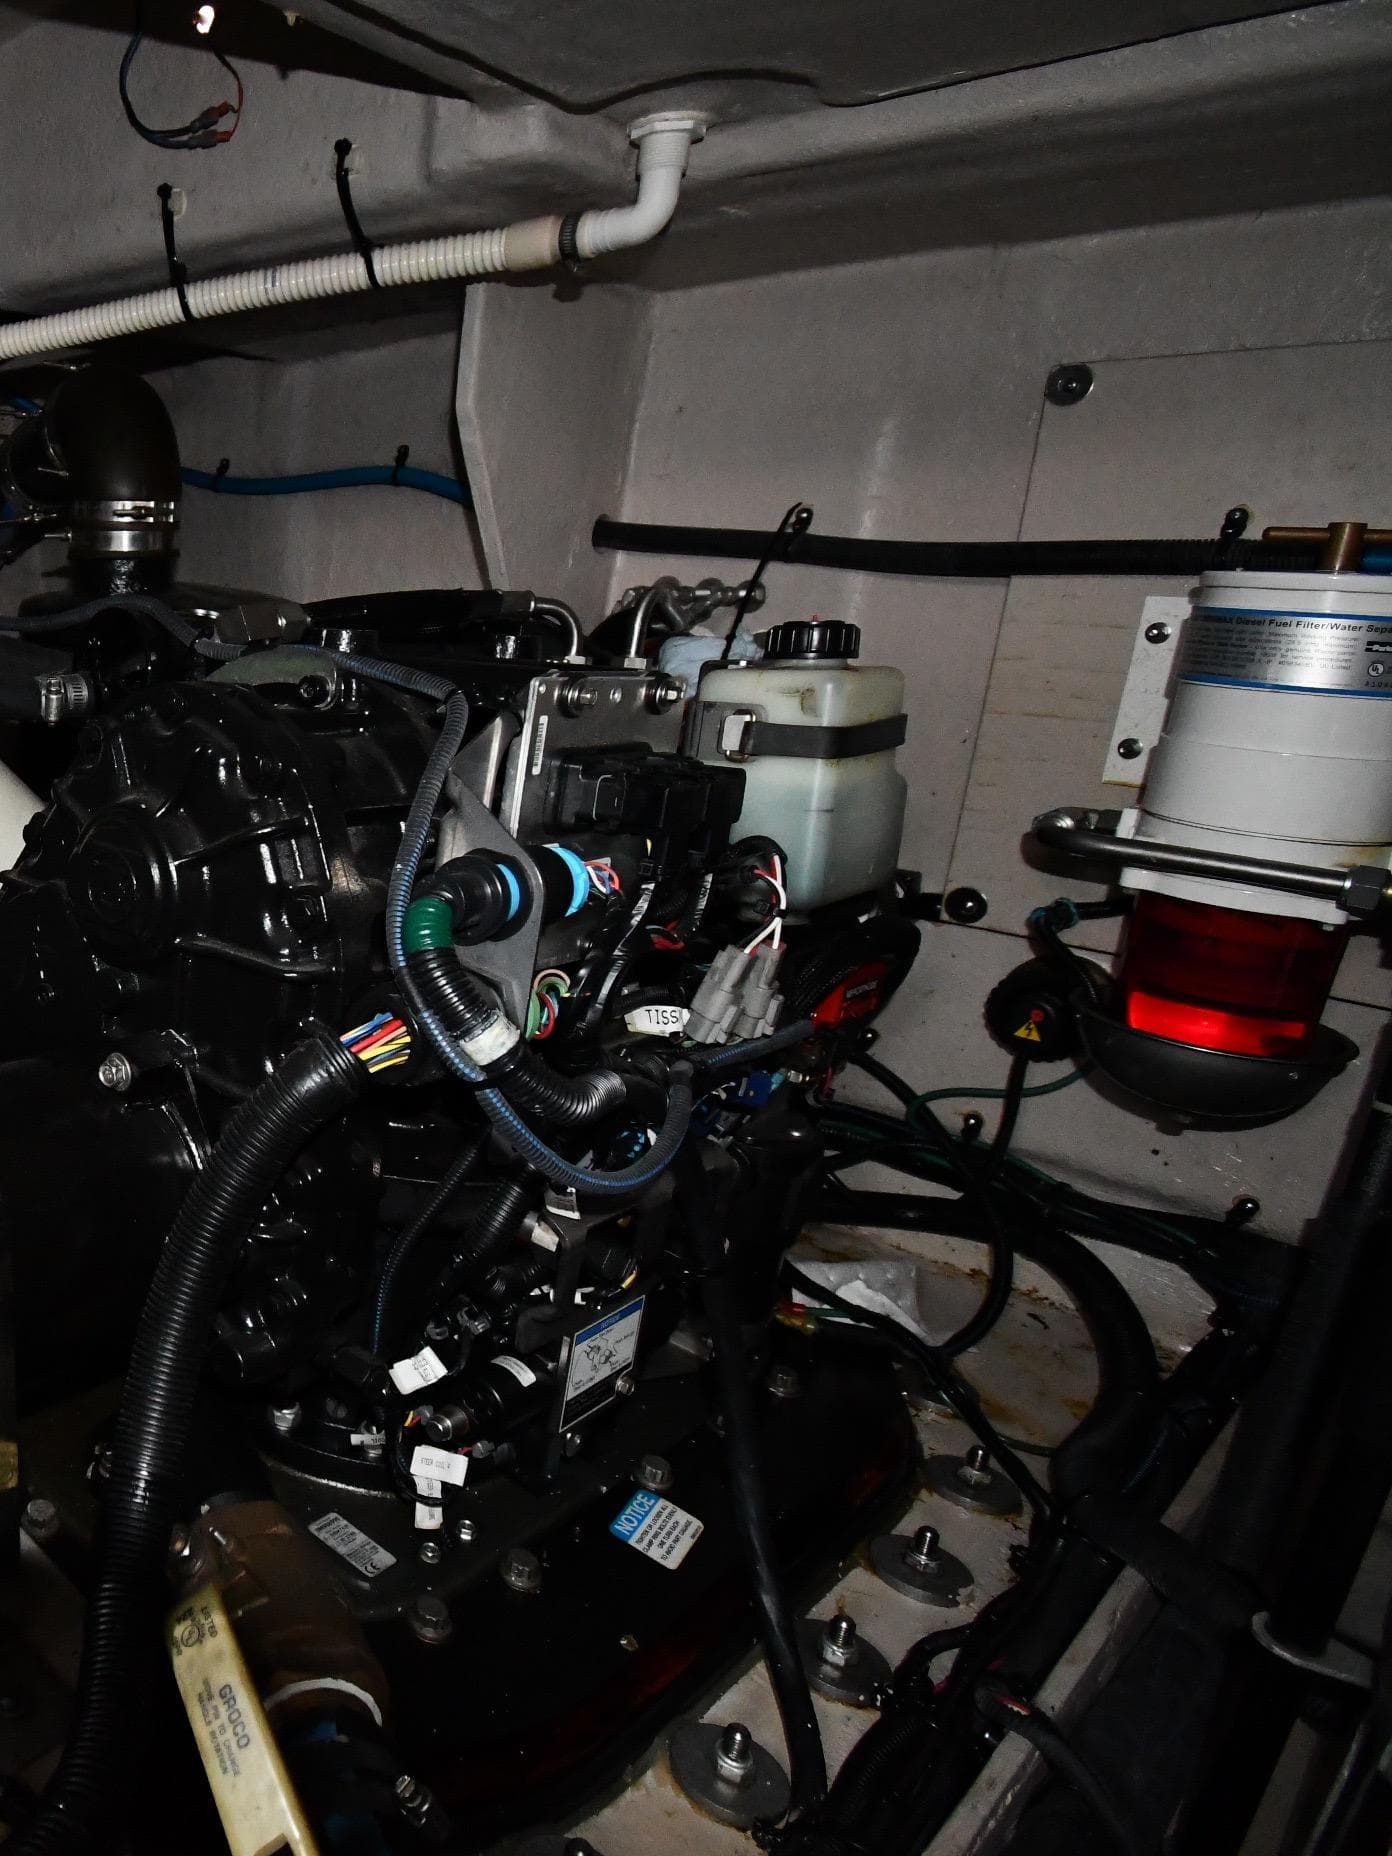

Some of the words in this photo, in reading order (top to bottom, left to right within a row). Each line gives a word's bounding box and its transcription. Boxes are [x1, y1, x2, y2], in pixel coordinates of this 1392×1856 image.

[1236, 616, 1267, 627] Diesel
[1268, 618, 1294, 628] Fuel
[1295, 620, 1364, 632] Filter/Water
[614, 1493, 656, 1536] NOTICE
[219, 1684, 250, 1749] GROCO
